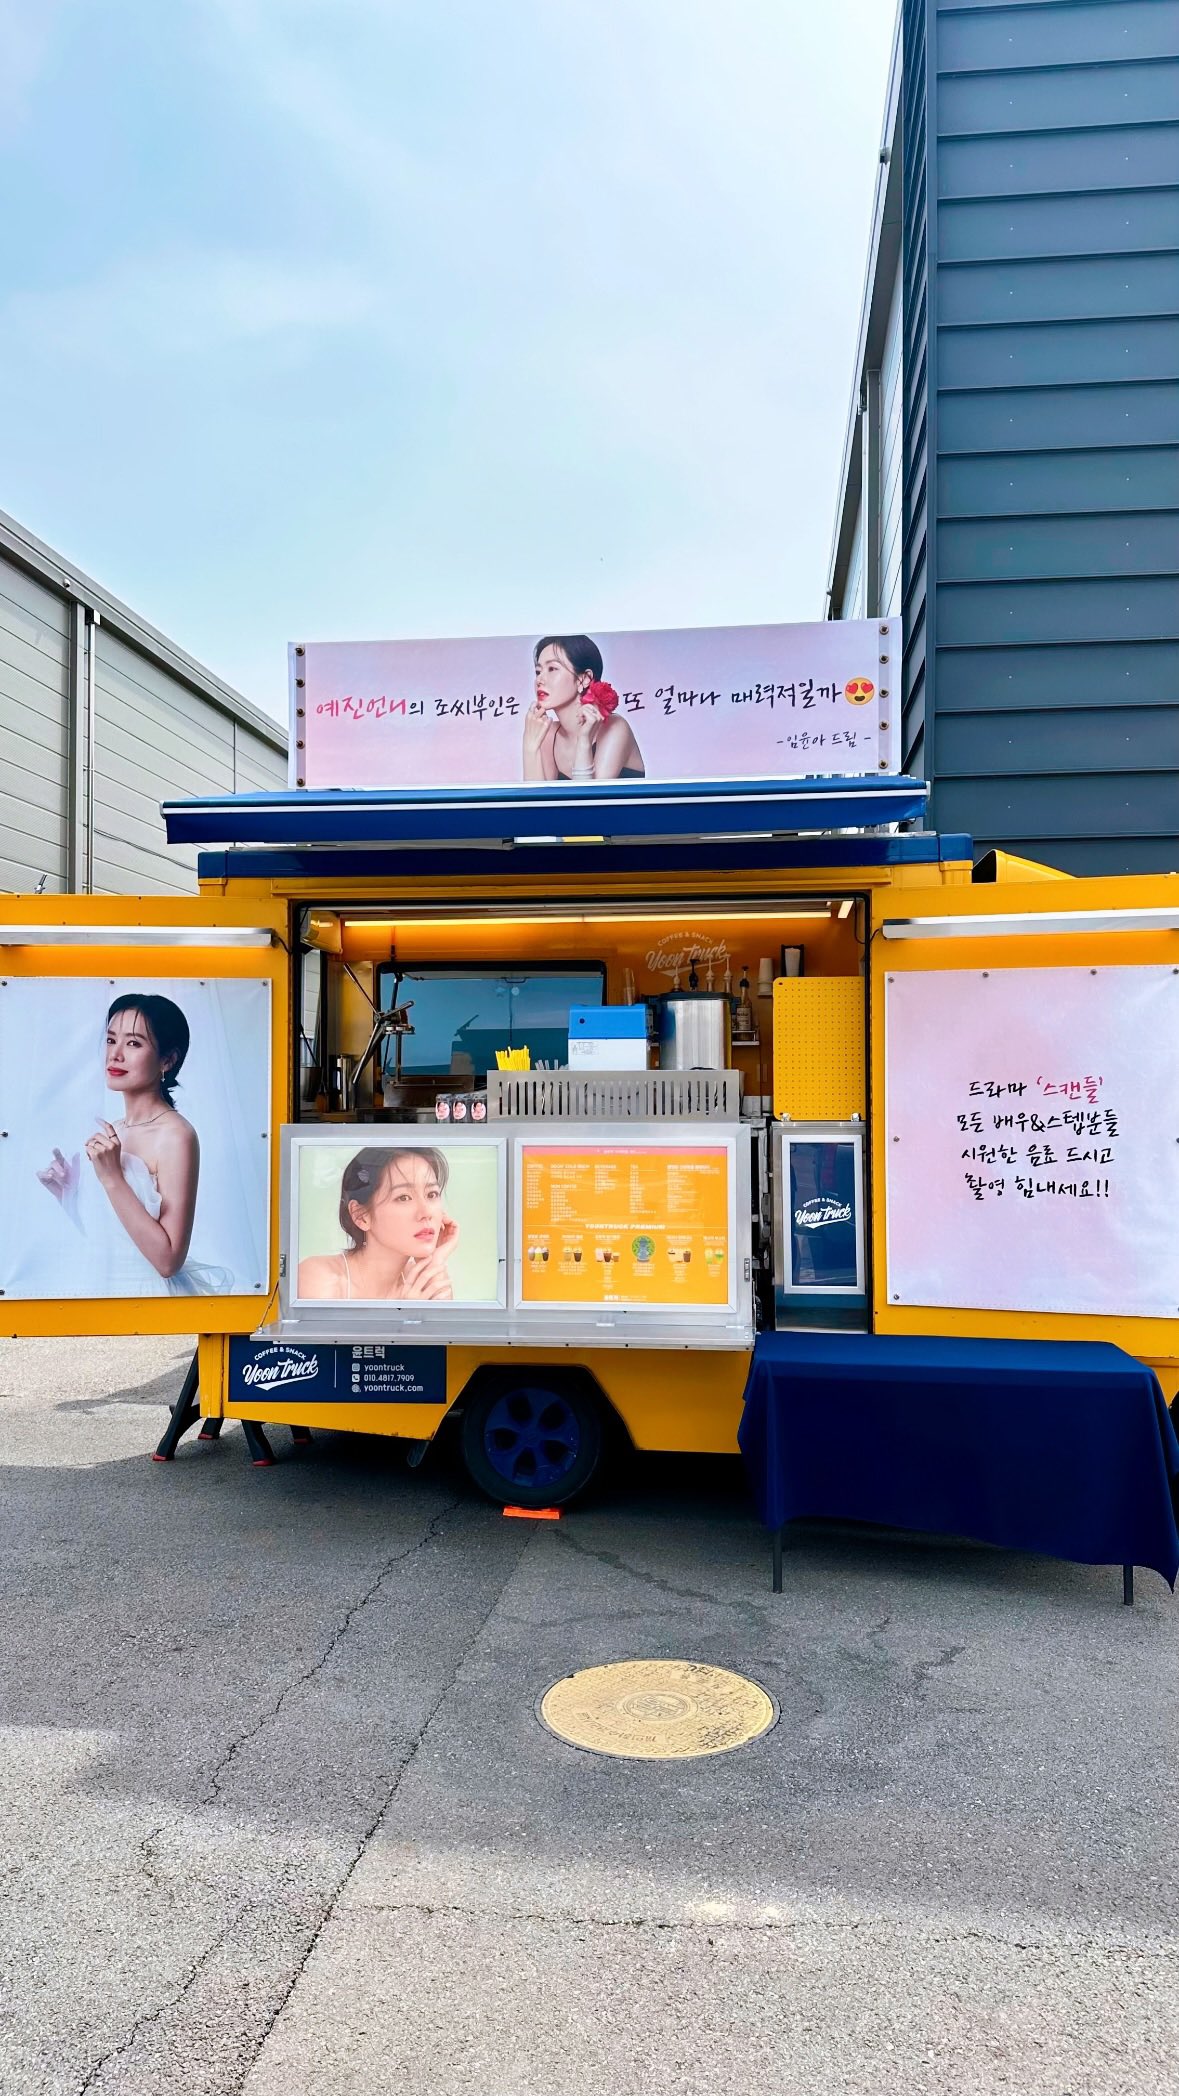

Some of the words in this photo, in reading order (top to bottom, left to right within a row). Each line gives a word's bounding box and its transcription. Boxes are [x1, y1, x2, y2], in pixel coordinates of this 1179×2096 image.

[316, 695, 424, 720] 예진언니의
[434, 693, 521, 722] 조씨부인은
[622, 690, 646, 713] 또
[654, 684, 721, 716] 얼마나
[731, 678, 843, 710] 매력적일까
[831, 731, 857, 748] 드림
[658, 932, 683, 946] COFFEE
[645, 949, 685, 972] Yoon
[968, 1080, 1028, 1098] 드라마
[956, 1111, 985, 1133] 모든
[961, 1144, 1018, 1165] 시원한
[1025, 1144, 1058, 1167] 음료
[1066, 1147, 1115, 1165] 드시고
[964, 1172, 1005, 1201] 촬영
[1014, 1175, 1109, 1199] 힘내세요!!
[795, 1210, 822, 1225] Yoon
[254, 1346, 278, 1361] COFFEE
[285, 1347, 307, 1360] SNACK
[352, 1345, 386, 1359] 윤트럭
[242, 1362, 280, 1386] Yoon
[364, 1363, 405, 1373] yoontruck
[363, 1374, 415, 1382] 010.4817.7909
[364, 1383, 424, 1393] yoontruck.com
